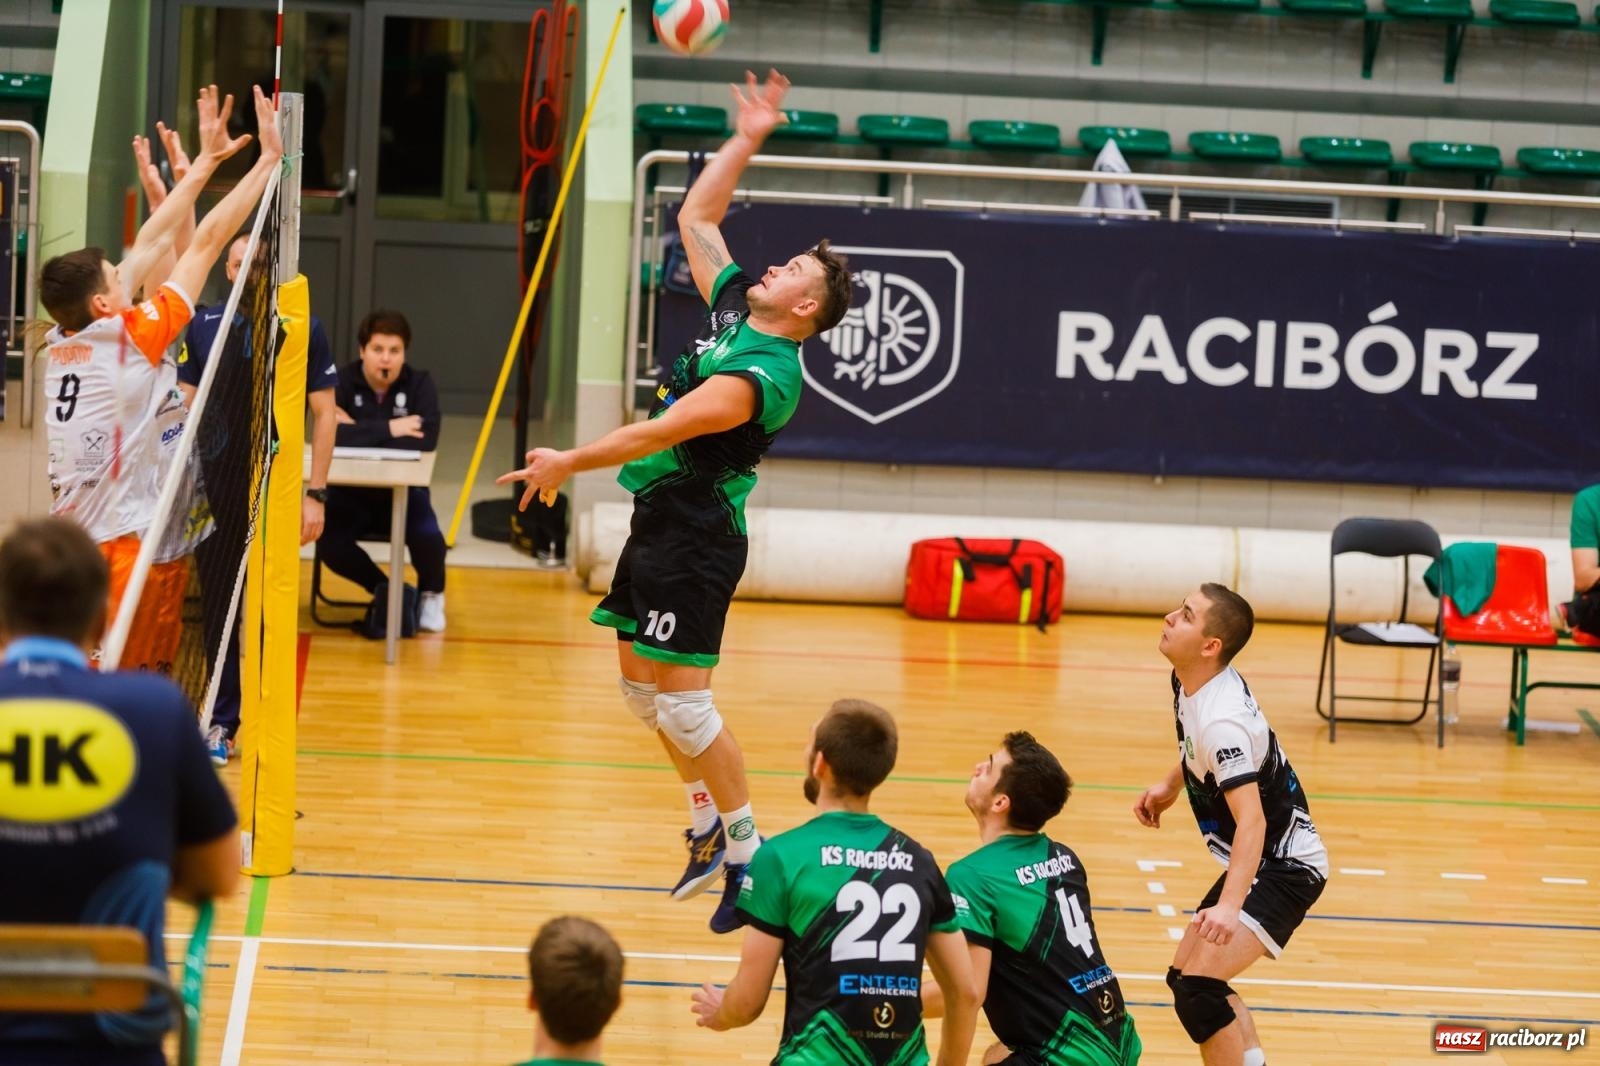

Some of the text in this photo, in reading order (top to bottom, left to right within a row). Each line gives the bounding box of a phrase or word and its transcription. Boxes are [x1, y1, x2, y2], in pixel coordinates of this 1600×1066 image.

[1056, 301, 1539, 400] RACIBÓRZ
[56, 373, 80, 422] 9
[644, 610, 676, 641] 10
[821, 843, 914, 872] KS RACIBÓRZ
[1015, 865, 1036, 886] KS
[830, 880, 921, 962] 22
[1055, 887, 1095, 959] 4
